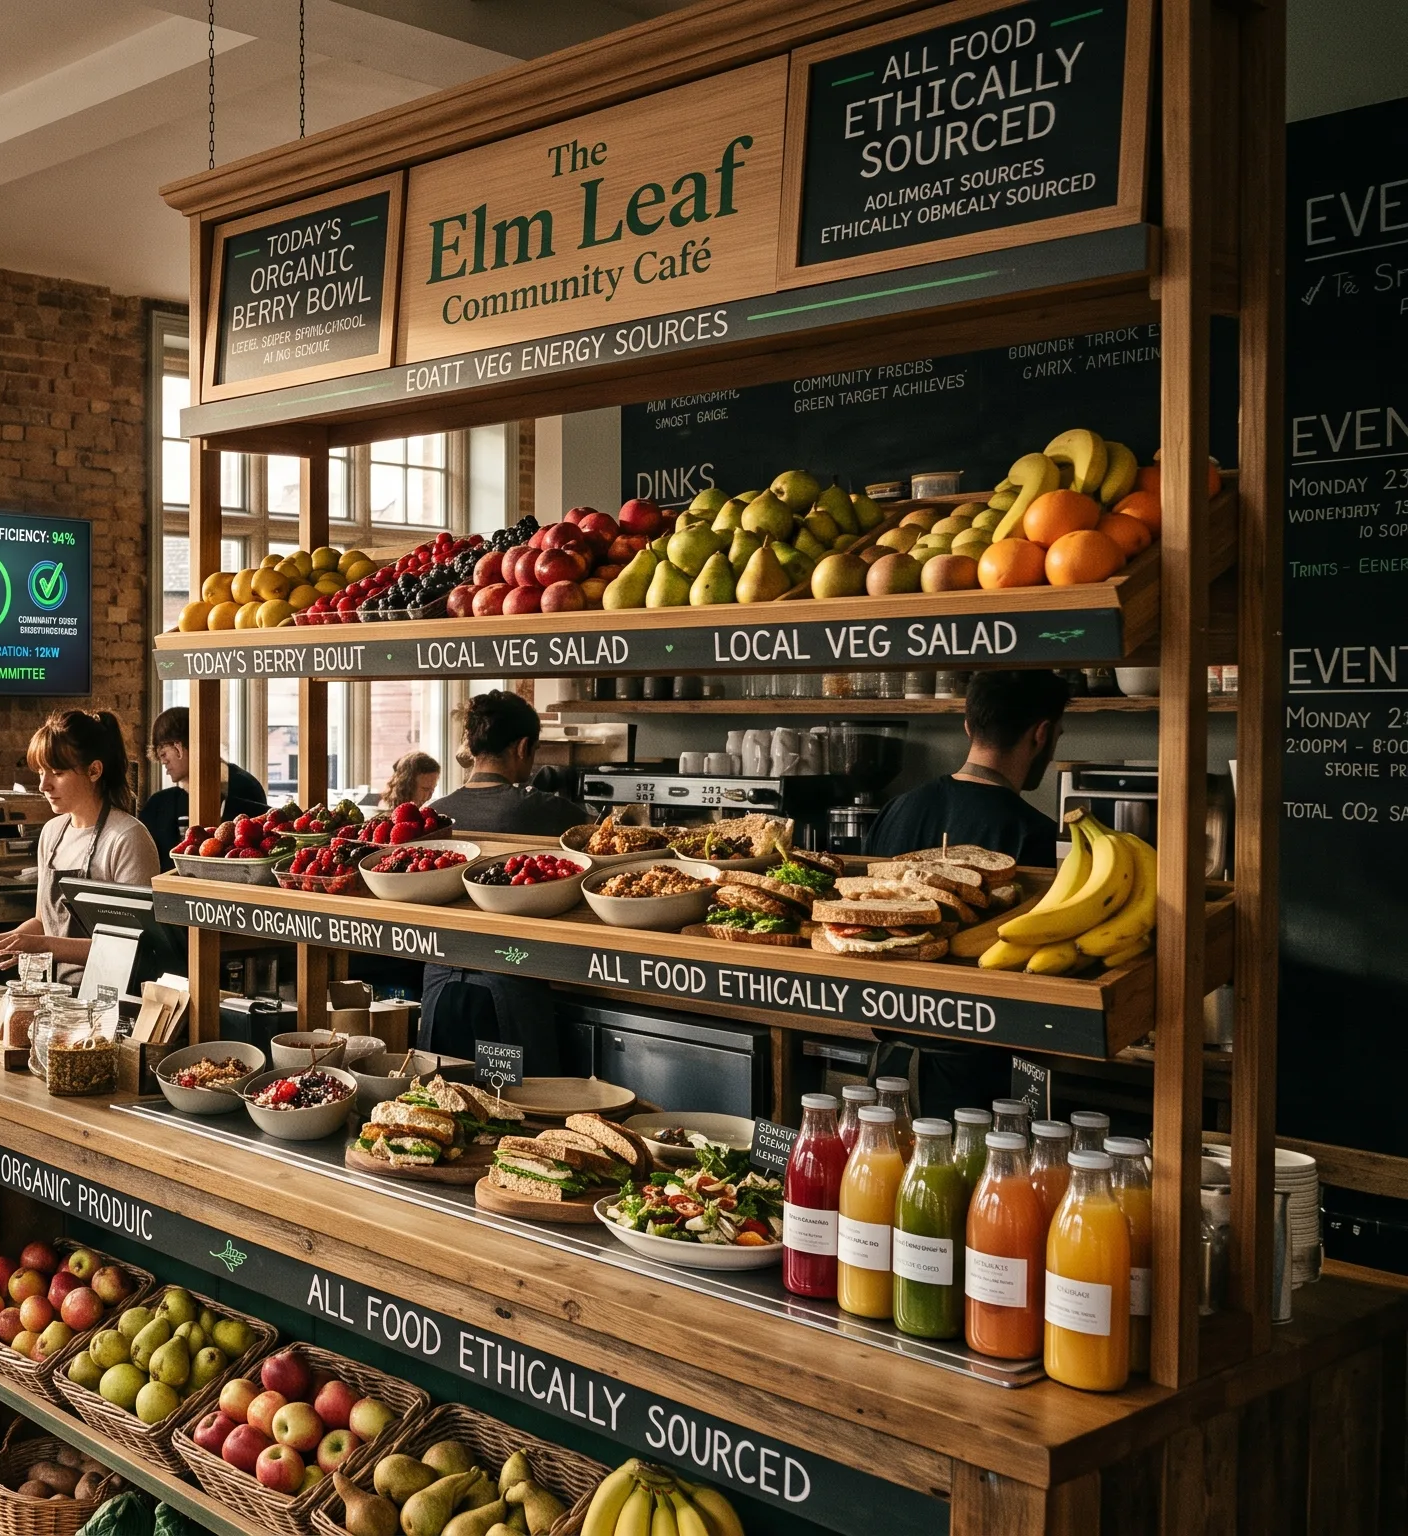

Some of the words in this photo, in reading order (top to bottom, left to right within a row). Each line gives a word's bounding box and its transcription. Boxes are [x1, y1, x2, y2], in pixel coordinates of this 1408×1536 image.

[882, 46, 939, 84] ALL
[949, 18, 1036, 66] FOOD
[844, 41, 1085, 139] ETHICALLY
[548, 139, 608, 178] The
[860, 100, 1056, 178] SOURCED
[960, 158, 1045, 192] SOURCES
[426, 203, 556, 285] Elm
[580, 135, 754, 248] Leaf
[821, 210, 913, 244] ETHICALLY
[1005, 172, 1097, 206] SOURCED
[267, 218, 342, 257] TODAY'S
[250, 244, 355, 294] ORGANIC
[441, 263, 625, 326] Community
[632, 237, 712, 286] Café
[232, 291, 301, 331] BERRY
[306, 275, 371, 315] BOWL
[474, 351, 513, 381] VEG
[521, 330, 604, 371] ENERGY
[614, 310, 729, 355] SOURCES
[793, 368, 873, 394] COMMUNITY
[794, 394, 835, 413] GREEN
[838, 385, 889, 406] TARGET
[1289, 477, 1369, 498] MONDAY
[52, 531, 76, 546] 94%
[34, 647, 60, 658] 12kW
[183, 649, 247, 676] TODAY'S
[253, 647, 307, 673] BERRY
[417, 640, 485, 669] LOCAL
[492, 638, 539, 667] VEG
[548, 635, 629, 666] SALAD
[714, 629, 811, 662] LOCAL
[824, 625, 892, 659] VEG
[907, 620, 1018, 656] SALAD
[1286, 706, 1371, 729] MONDAY
[1286, 738, 1347, 754] 2:00PM
[1283, 801, 1333, 819] TOTAL
[184, 900, 247, 929] TODAY'S
[252, 908, 323, 940] ORGANIC
[328, 920, 384, 949] BERRY
[392, 927, 446, 958] BOWL
[587, 952, 630, 984] ALL
[640, 959, 707, 994] FOOD
[718, 969, 849, 1013] ETHICALLY
[861, 987, 996, 1034] SOURCED
[0, 1154, 71, 1207] ORGANIC
[306, 1273, 355, 1325] ALL
[366, 1295, 442, 1355] FOOD
[458, 1330, 626, 1432] ETHICALLY
[645, 1404, 811, 1503] SOURCED
